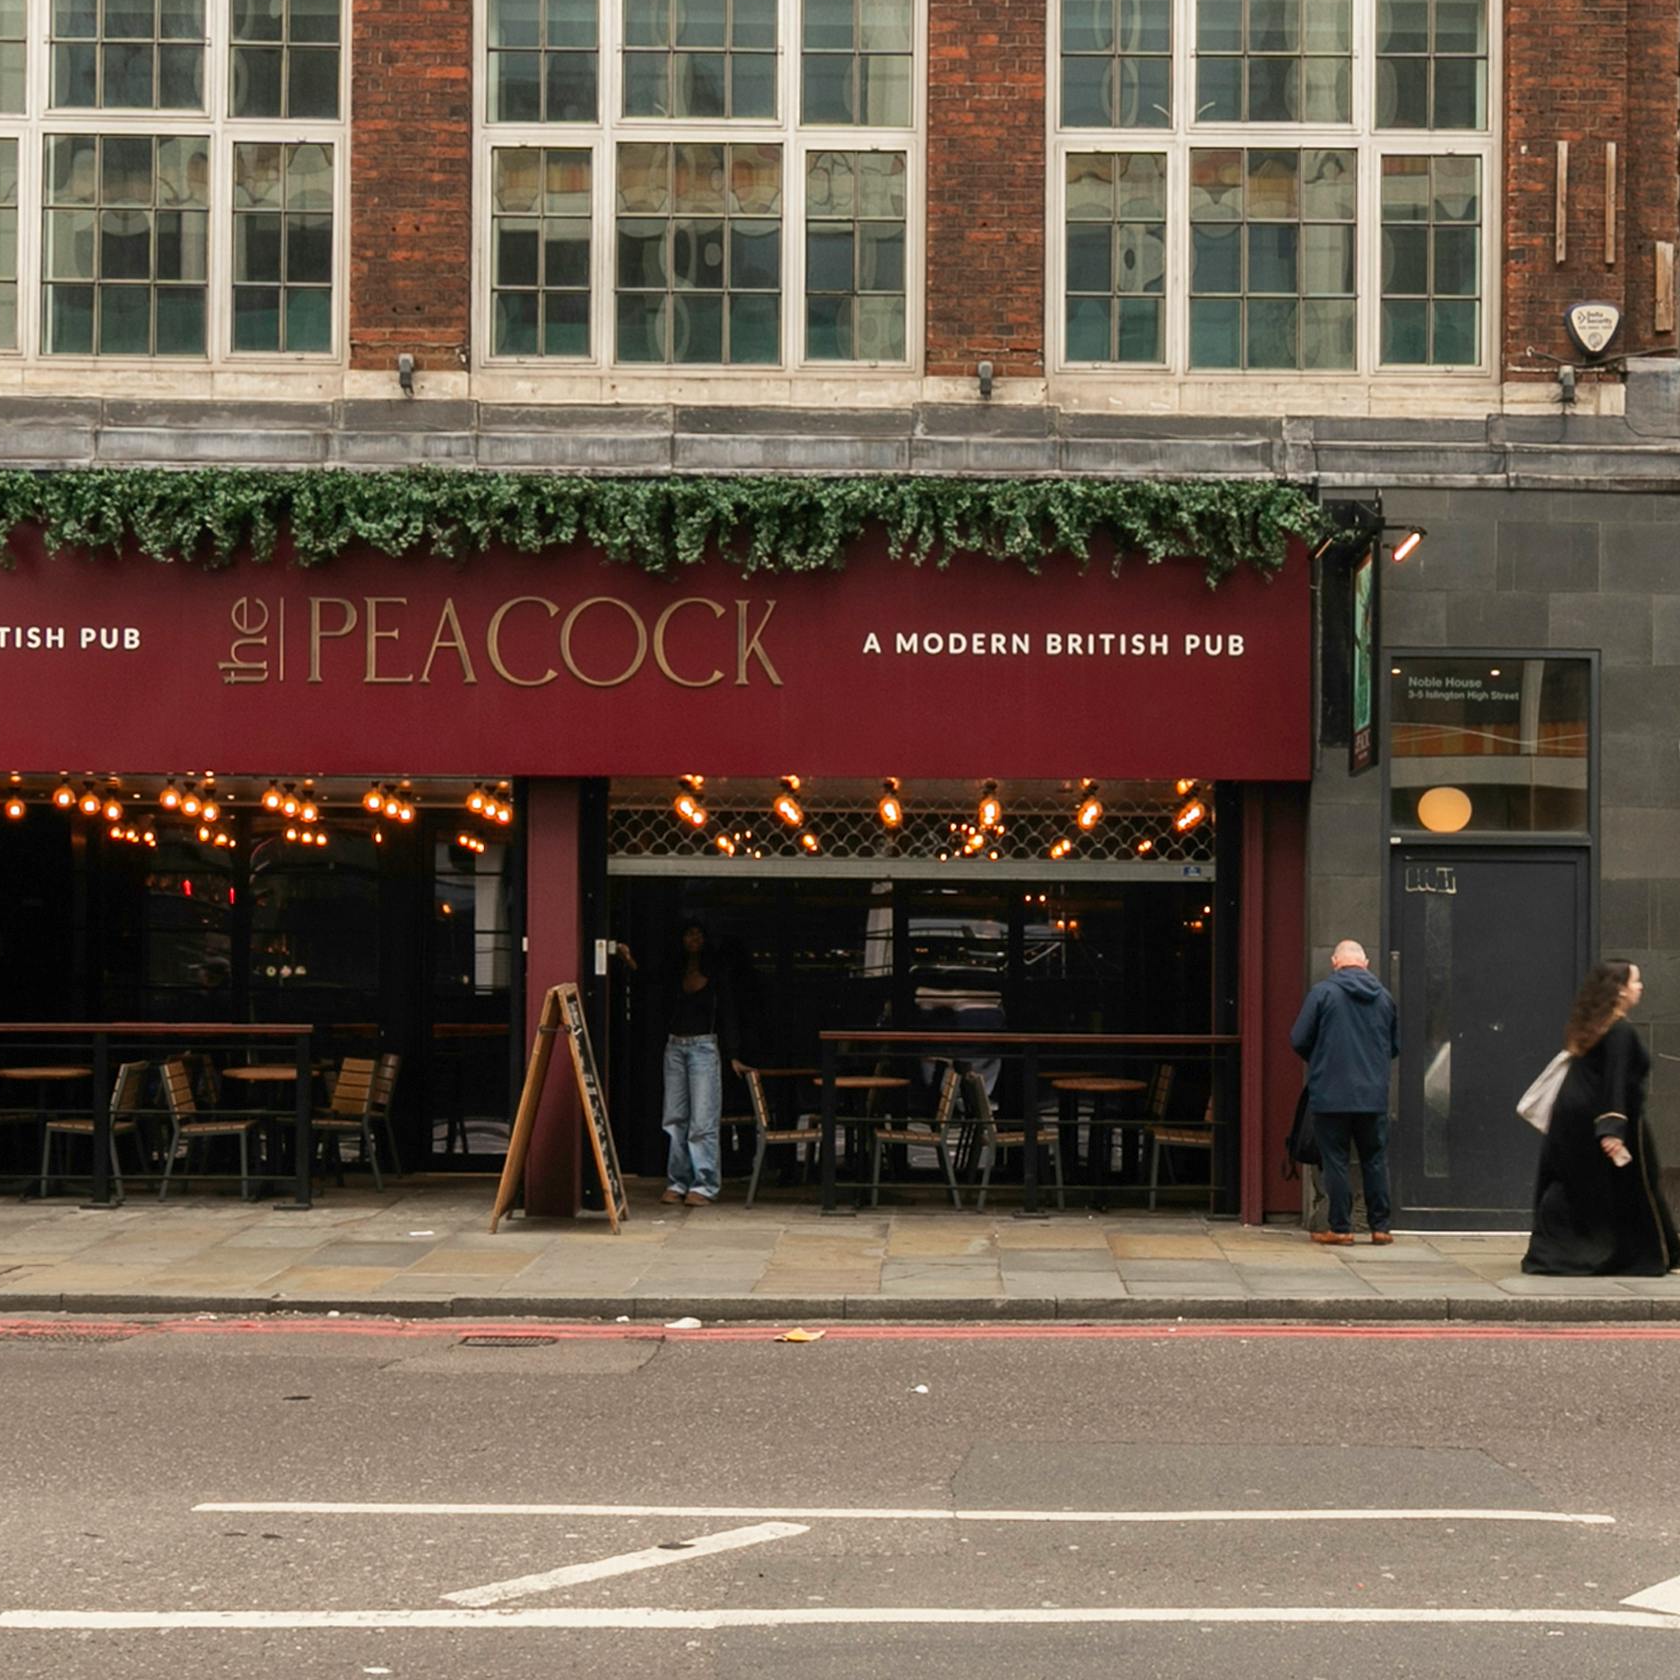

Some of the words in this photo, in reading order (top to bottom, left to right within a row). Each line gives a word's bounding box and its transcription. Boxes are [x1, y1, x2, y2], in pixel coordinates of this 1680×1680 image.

[80, 627, 141, 649] PUB
[218, 595, 270, 685] the
[307, 596, 784, 687] PEACOCK
[862, 633, 881, 654] A
[895, 632, 1031, 655] MODERN
[1046, 633, 1169, 656] BRITISH
[1185, 634, 1245, 656] PUB
[1408, 676, 1442, 687] Noble
[1445, 677, 1482, 688] House
[1490, 691, 1519, 700] Street
